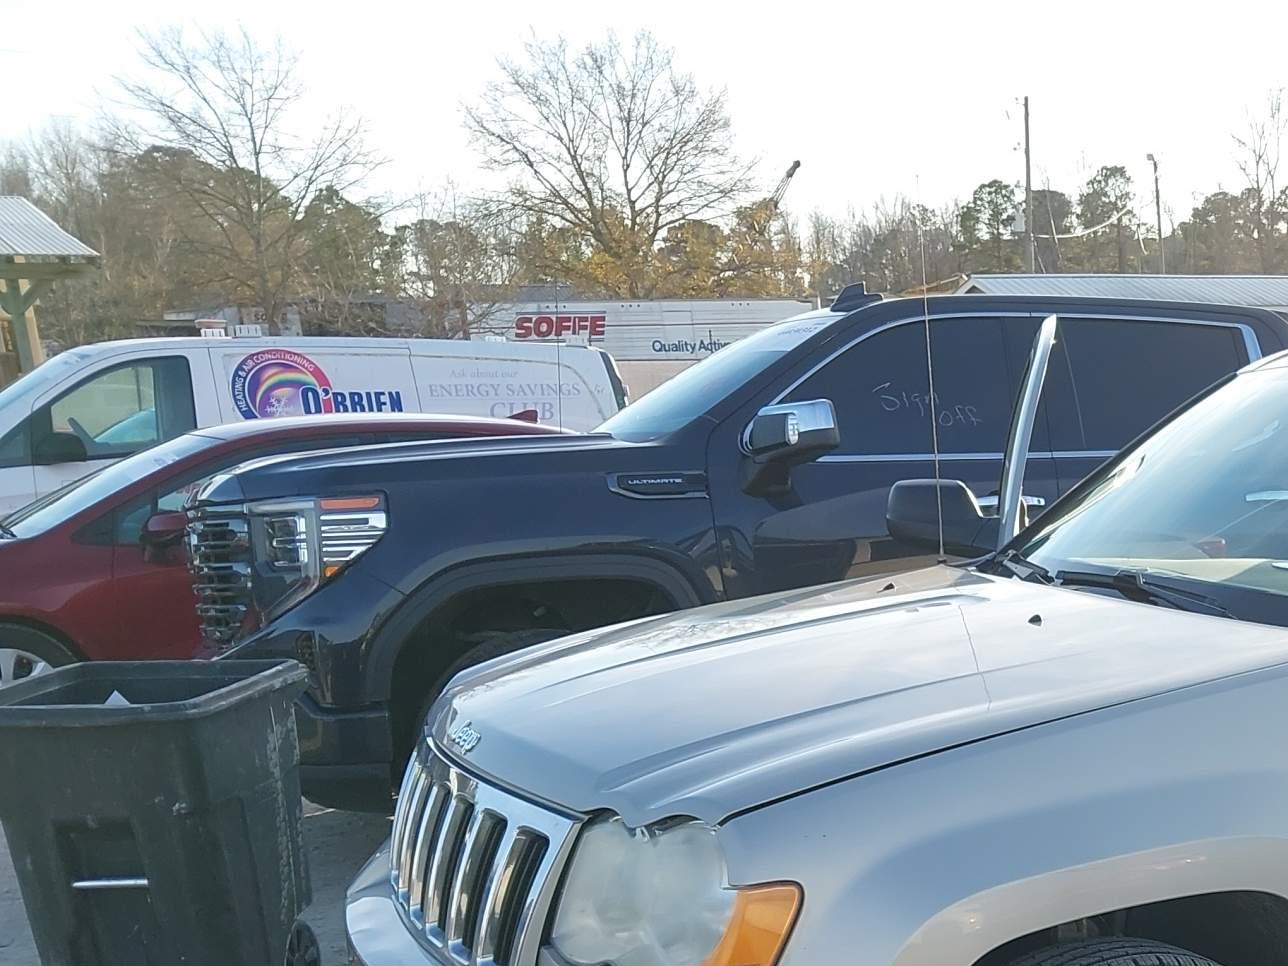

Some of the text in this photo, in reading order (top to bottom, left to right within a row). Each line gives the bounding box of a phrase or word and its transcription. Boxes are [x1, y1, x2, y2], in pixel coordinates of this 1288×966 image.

[515, 316, 606, 338] SOFFE
[652, 339, 697, 355] Quality
[236, 376, 247, 412] HEATING
[244, 358, 257, 372] AIR
[254, 351, 315, 372] CONDITIONING
[449, 368, 518, 379] Ask about our
[301, 386, 403, 415] O'BRIEN
[428, 383, 502, 398] ENERGY
[505, 383, 581, 398] SAVINGS
[452, 719, 482, 755] Jeep
